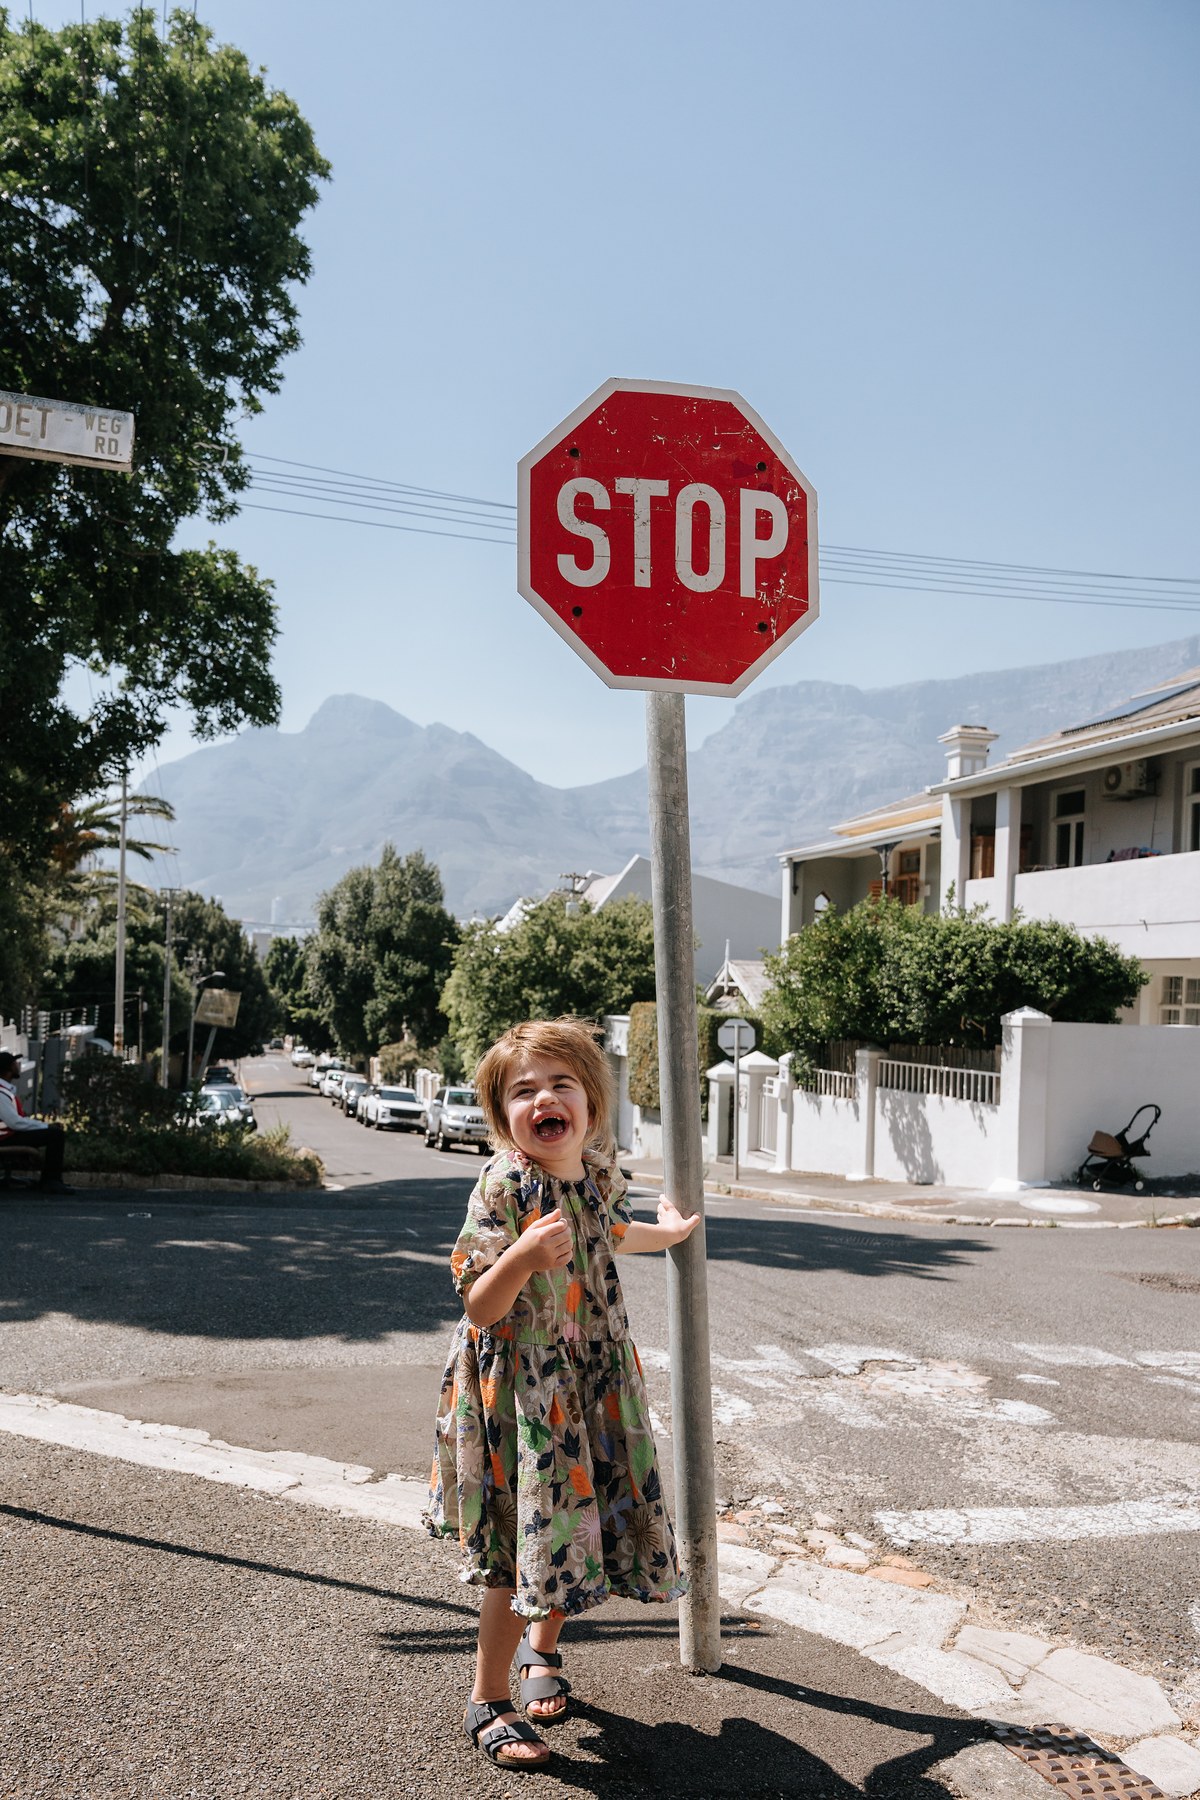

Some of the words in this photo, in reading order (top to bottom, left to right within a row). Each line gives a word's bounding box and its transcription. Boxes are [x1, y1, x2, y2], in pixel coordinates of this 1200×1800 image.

[85, 413, 121, 434] WEG
[95, 436, 122, 456] RD.
[557, 477, 788, 598] STOP
